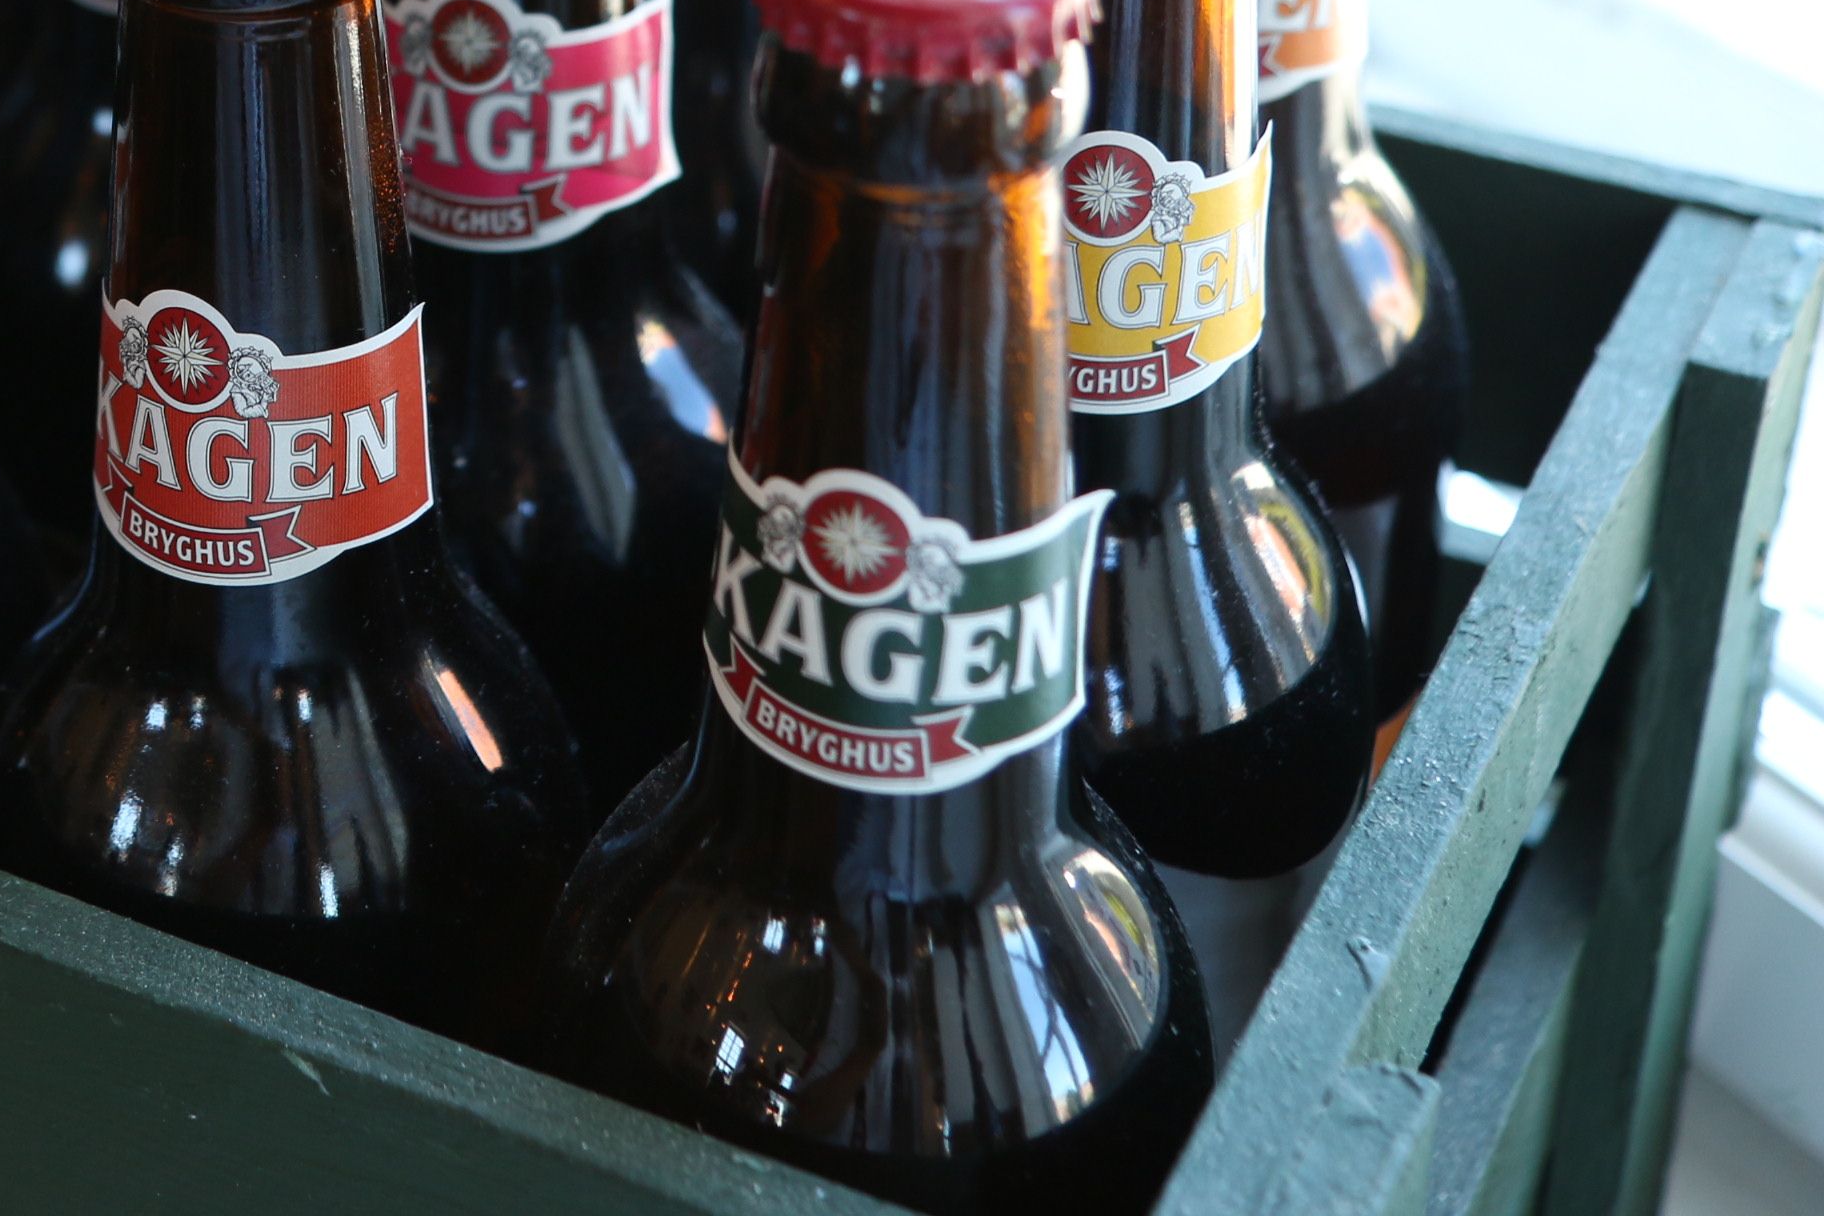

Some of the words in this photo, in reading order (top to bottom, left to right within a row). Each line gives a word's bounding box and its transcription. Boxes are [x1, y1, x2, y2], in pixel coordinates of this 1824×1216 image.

[96, 357, 399, 504] KAGEN
[129, 511, 256, 568] BRYGHUS
[712, 519, 1070, 706] KAGEN
[756, 698, 915, 774] BRYGHUS
